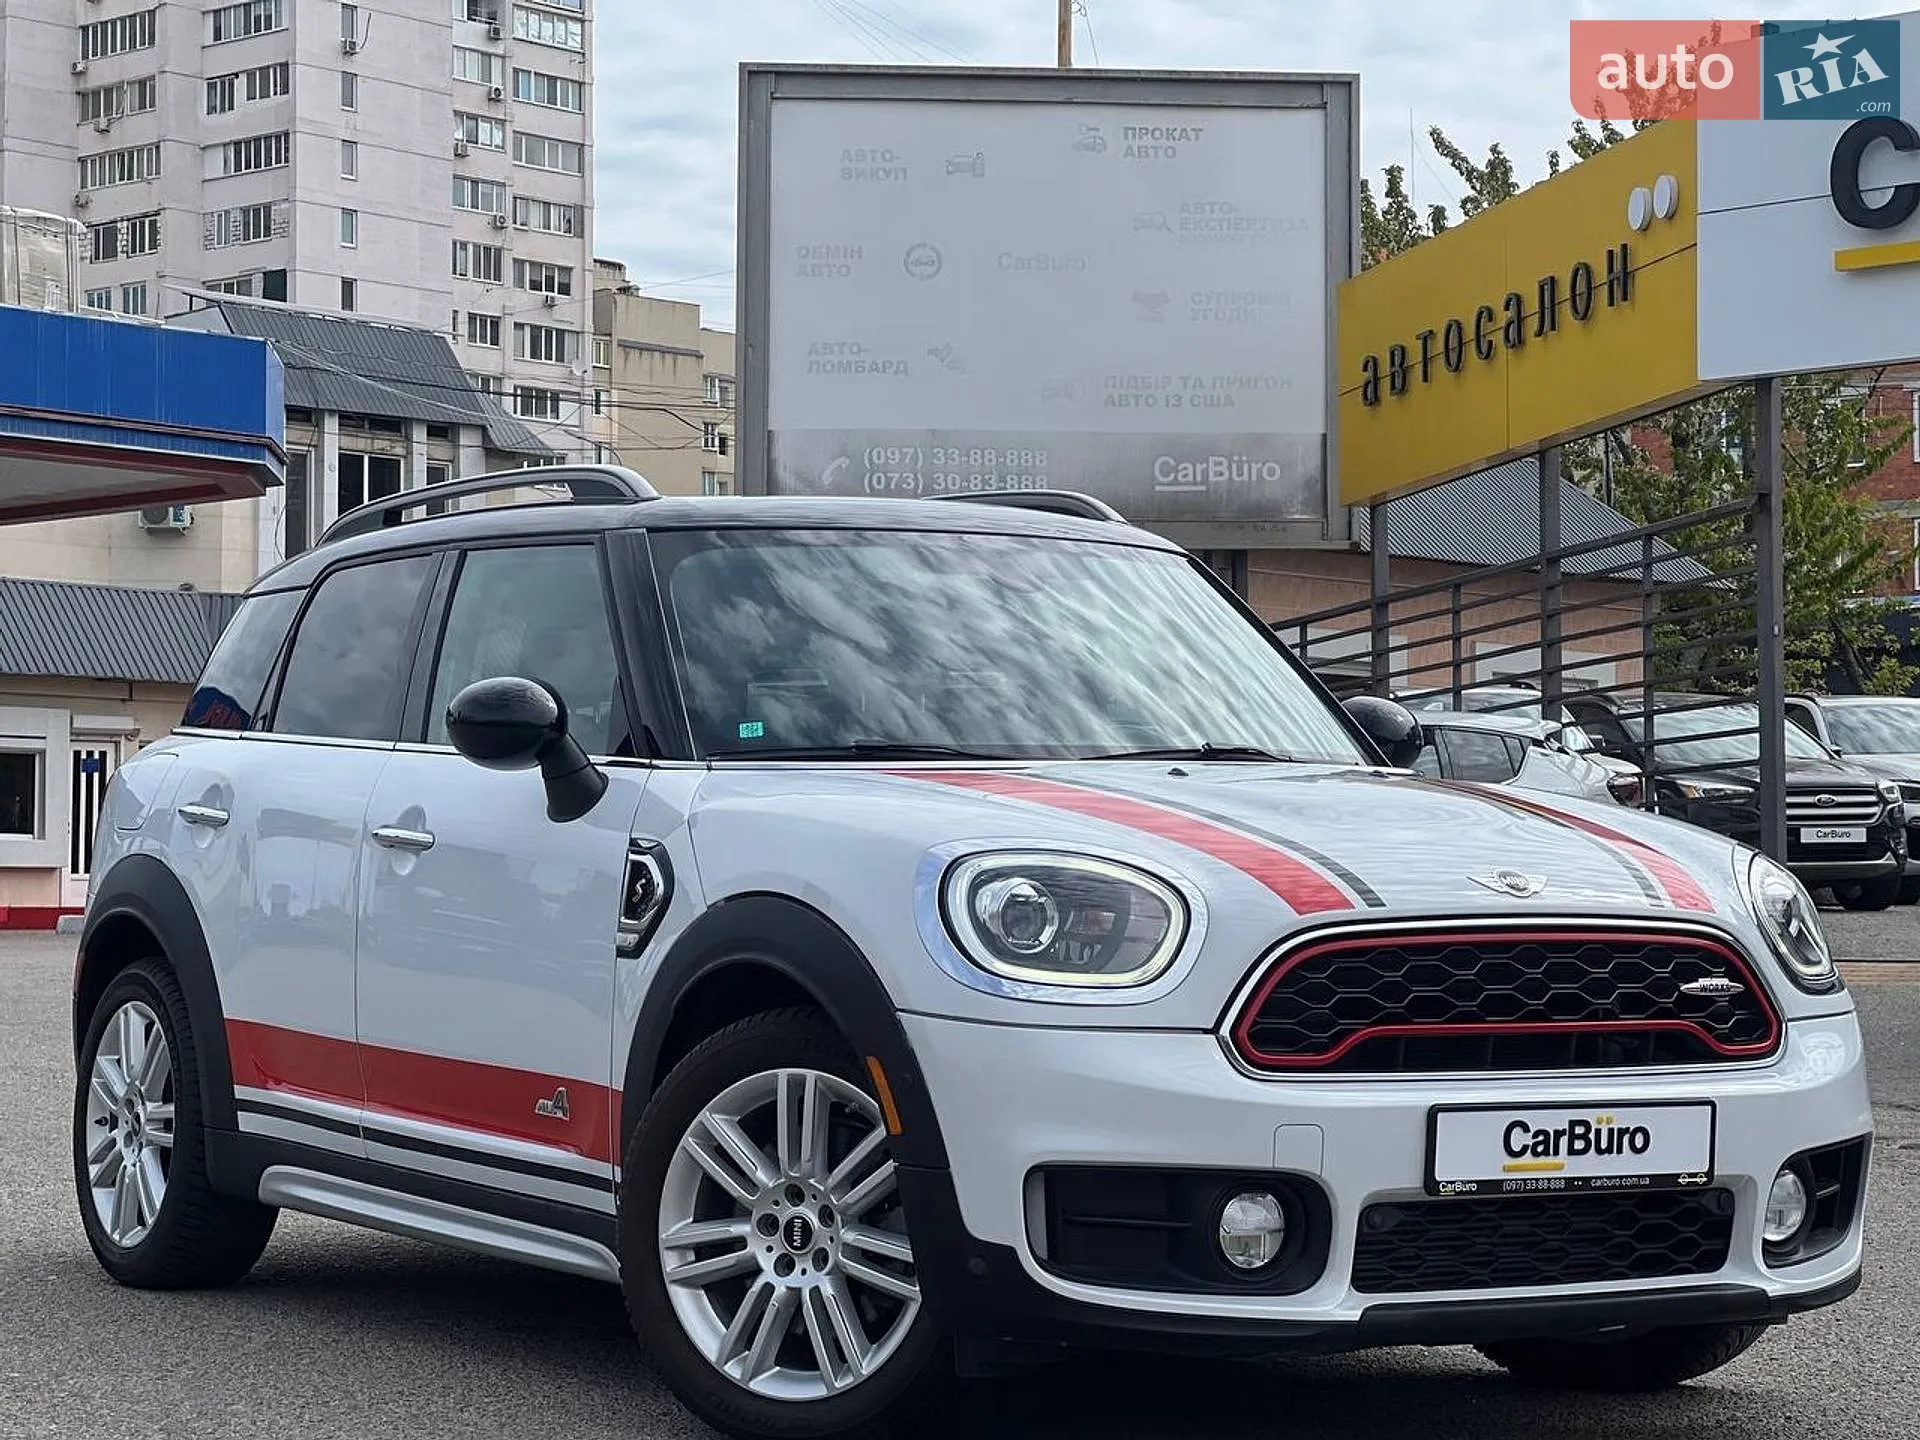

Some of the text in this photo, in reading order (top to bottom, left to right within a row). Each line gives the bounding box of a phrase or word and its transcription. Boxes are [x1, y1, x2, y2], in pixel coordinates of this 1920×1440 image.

[1122, 125, 1204, 142] ПРОКАТ
[839, 148, 902, 164] АВТО-
[1122, 144, 1178, 160] АВТО
[839, 165, 909, 182] ВИКУП
[1179, 201, 1240, 216] АВТО-
[796, 263, 851, 279] АВТО
[1360, 243, 1634, 408] автосалон
[806, 341, 871, 358] АВТО-
[806, 359, 909, 377] ЛОМБАРД
[1104, 374, 1293, 391] ПІДБІР ТА ПРИГОН
[1103, 393, 1235, 409] АВТО ІЗ США
[863, 446, 1048, 469] (097) 33-88-888
[1154, 455, 1281, 482] CarBüro
[863, 471, 1048, 493] (073) 30-83-888
[1503, 1115, 1650, 1159] CarBüro
[1502, 1179, 1566, 1192] (097) 33-88-888
[792, 1218, 803, 1247] MINI
